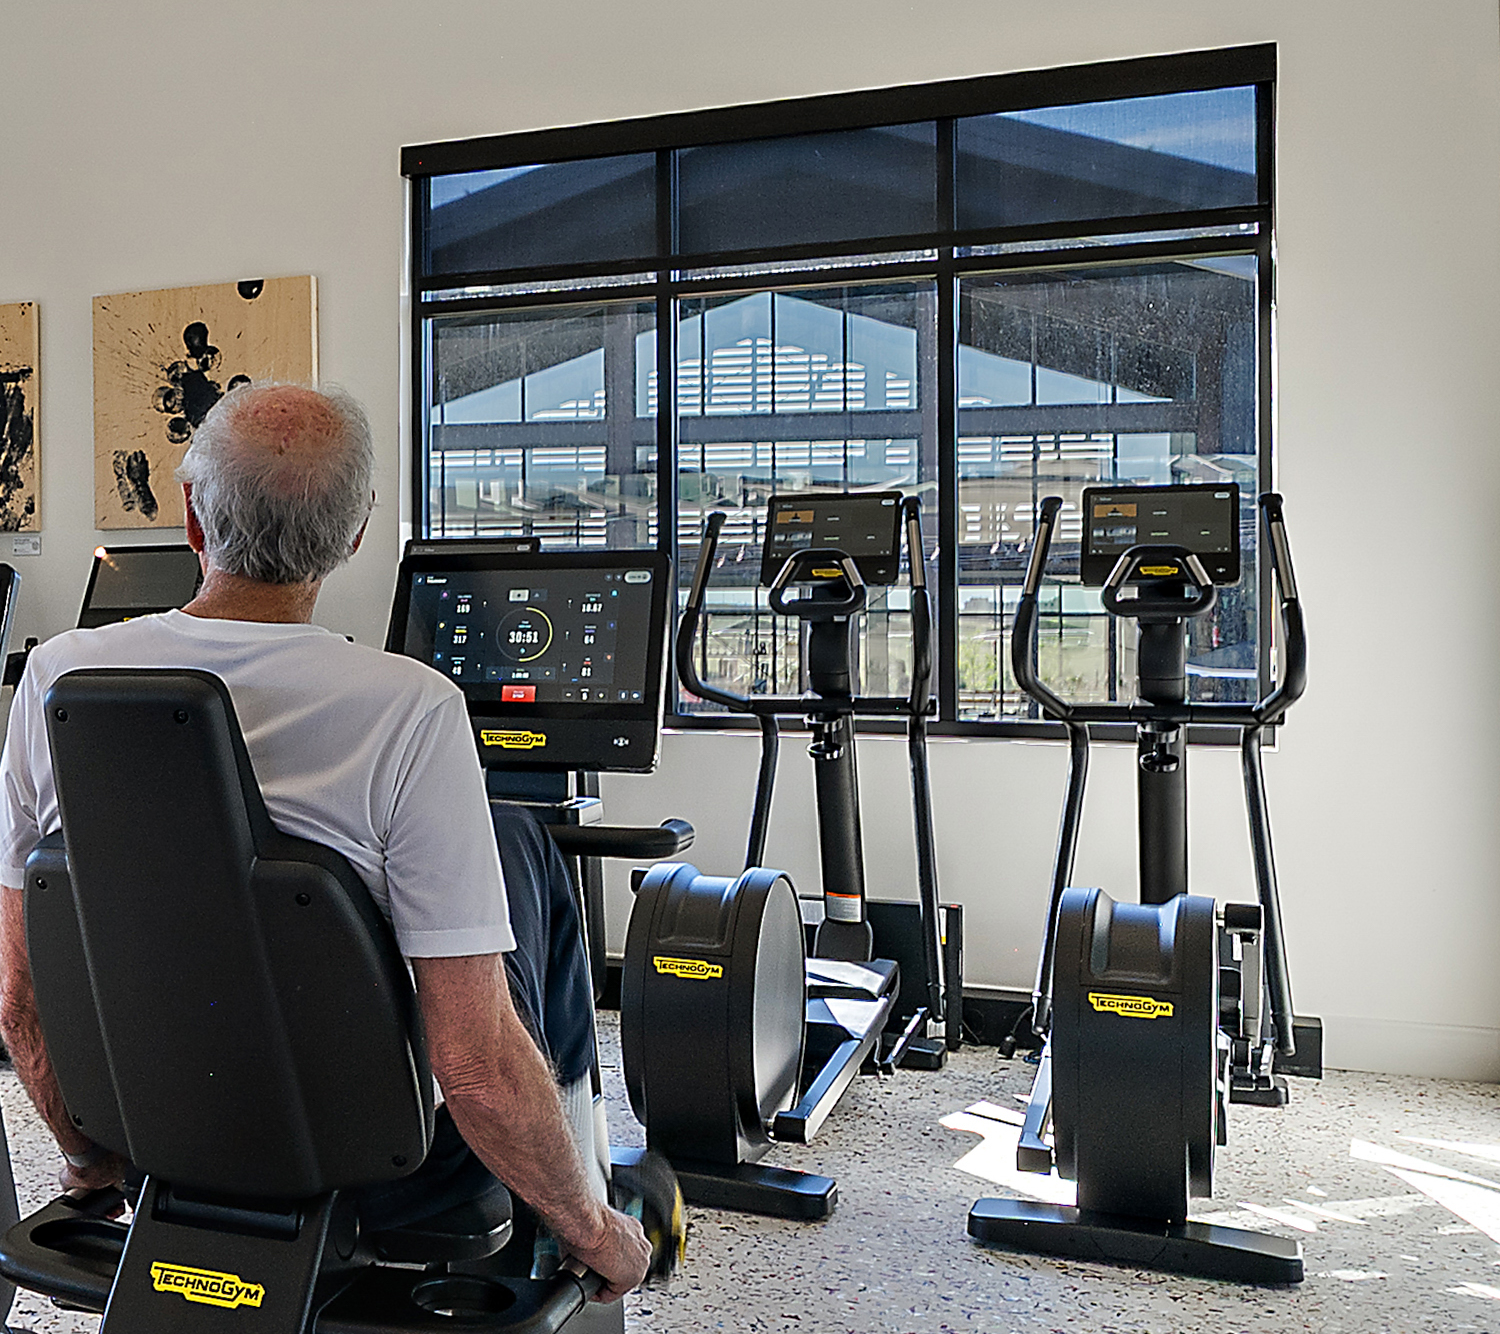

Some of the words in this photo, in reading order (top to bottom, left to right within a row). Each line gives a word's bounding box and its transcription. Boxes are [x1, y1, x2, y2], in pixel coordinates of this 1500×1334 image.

[508, 631, 539, 643] 30:51
[483, 733, 544, 746] TECHNOGYM
[656, 959, 720, 975] TECHNOGYM
[1091, 996, 1170, 1014] TECHNOGYM
[154, 1266, 260, 1302] TECHNOGYM
